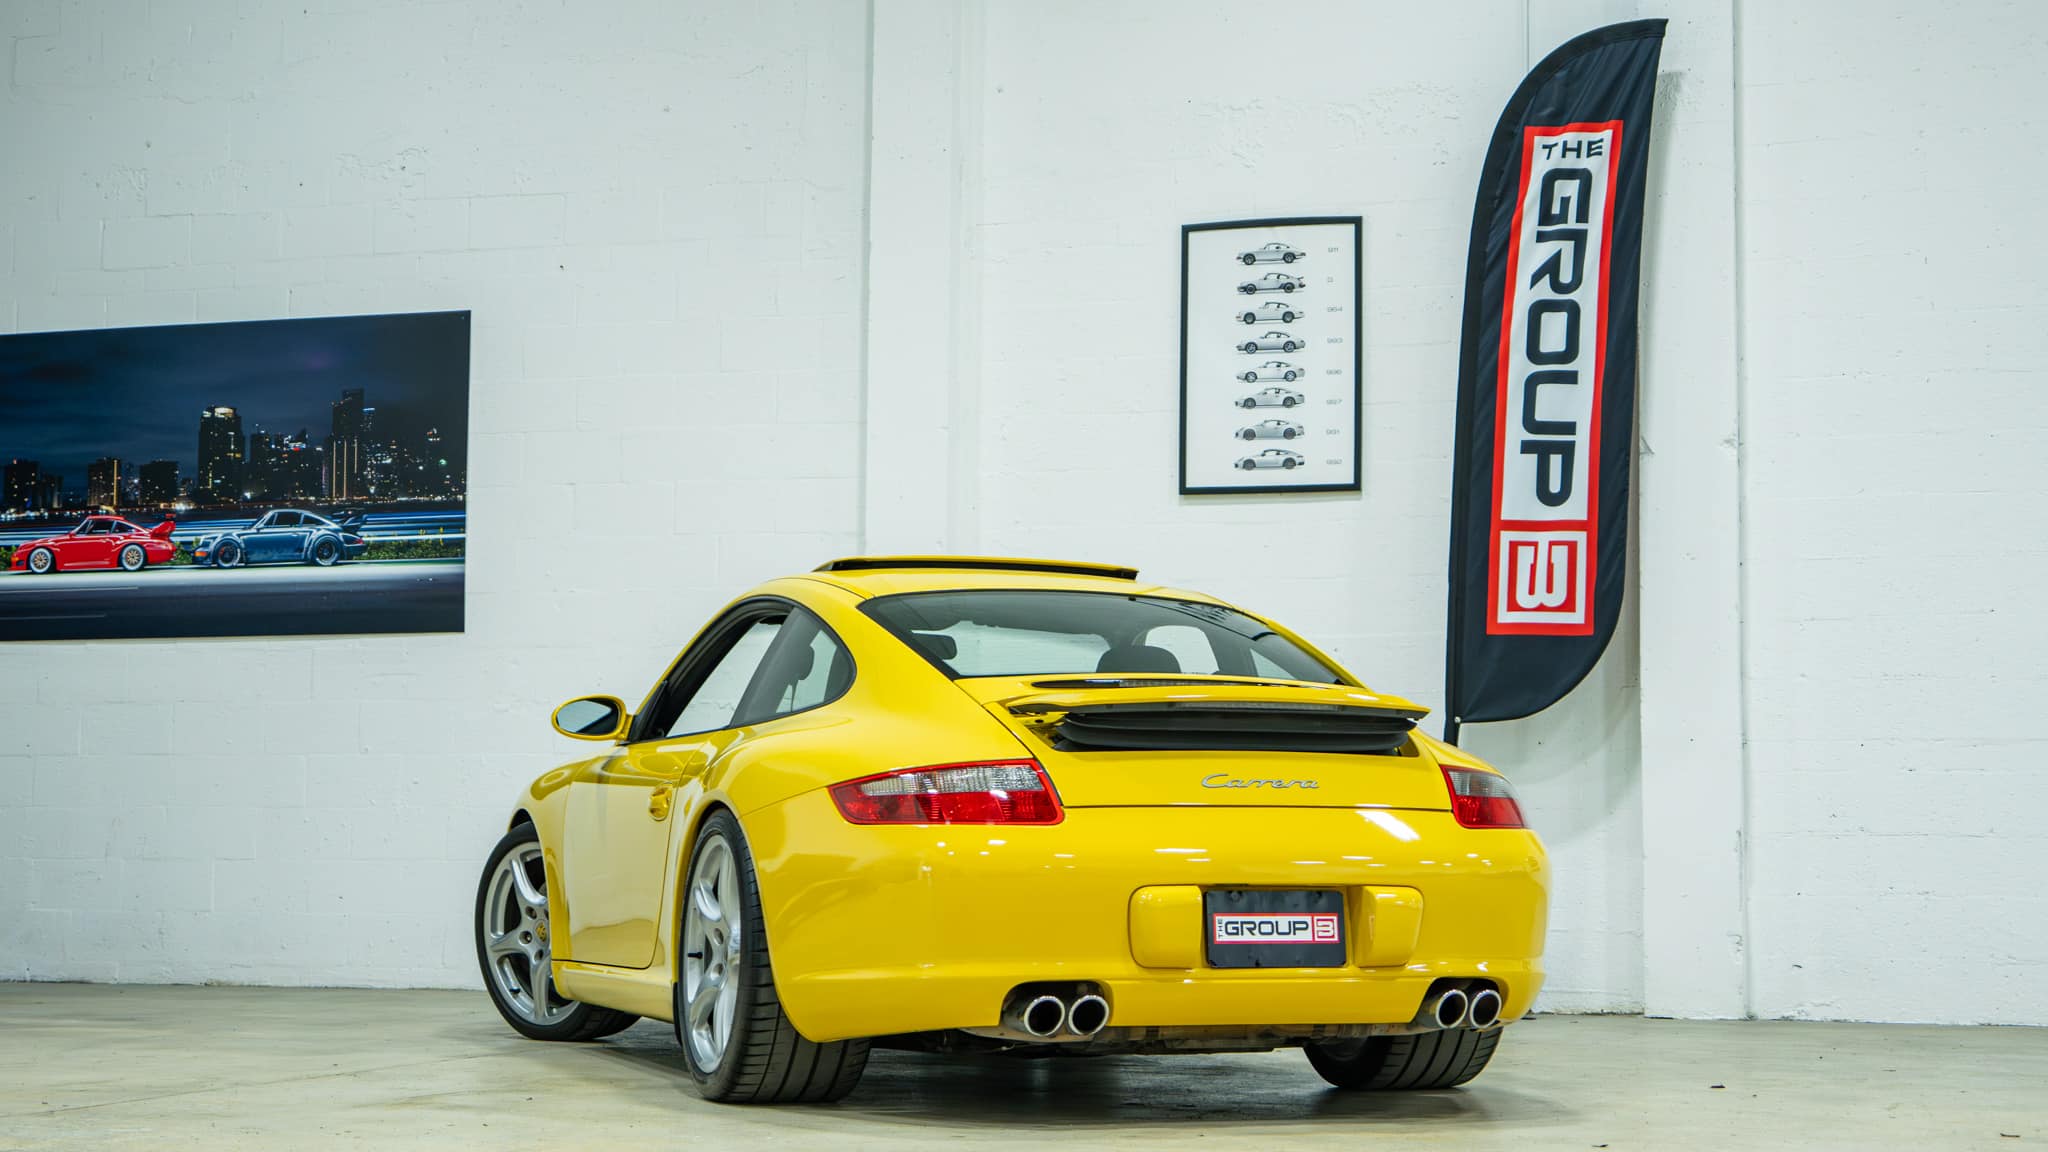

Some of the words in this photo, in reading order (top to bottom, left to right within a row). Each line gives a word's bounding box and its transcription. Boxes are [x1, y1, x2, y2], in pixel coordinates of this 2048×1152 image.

[1542, 137, 1604, 160] THE
[1519, 166, 1593, 508] GROUP
[1201, 773, 1320, 789] Carrera
[1224, 920, 1309, 937] GROUP
